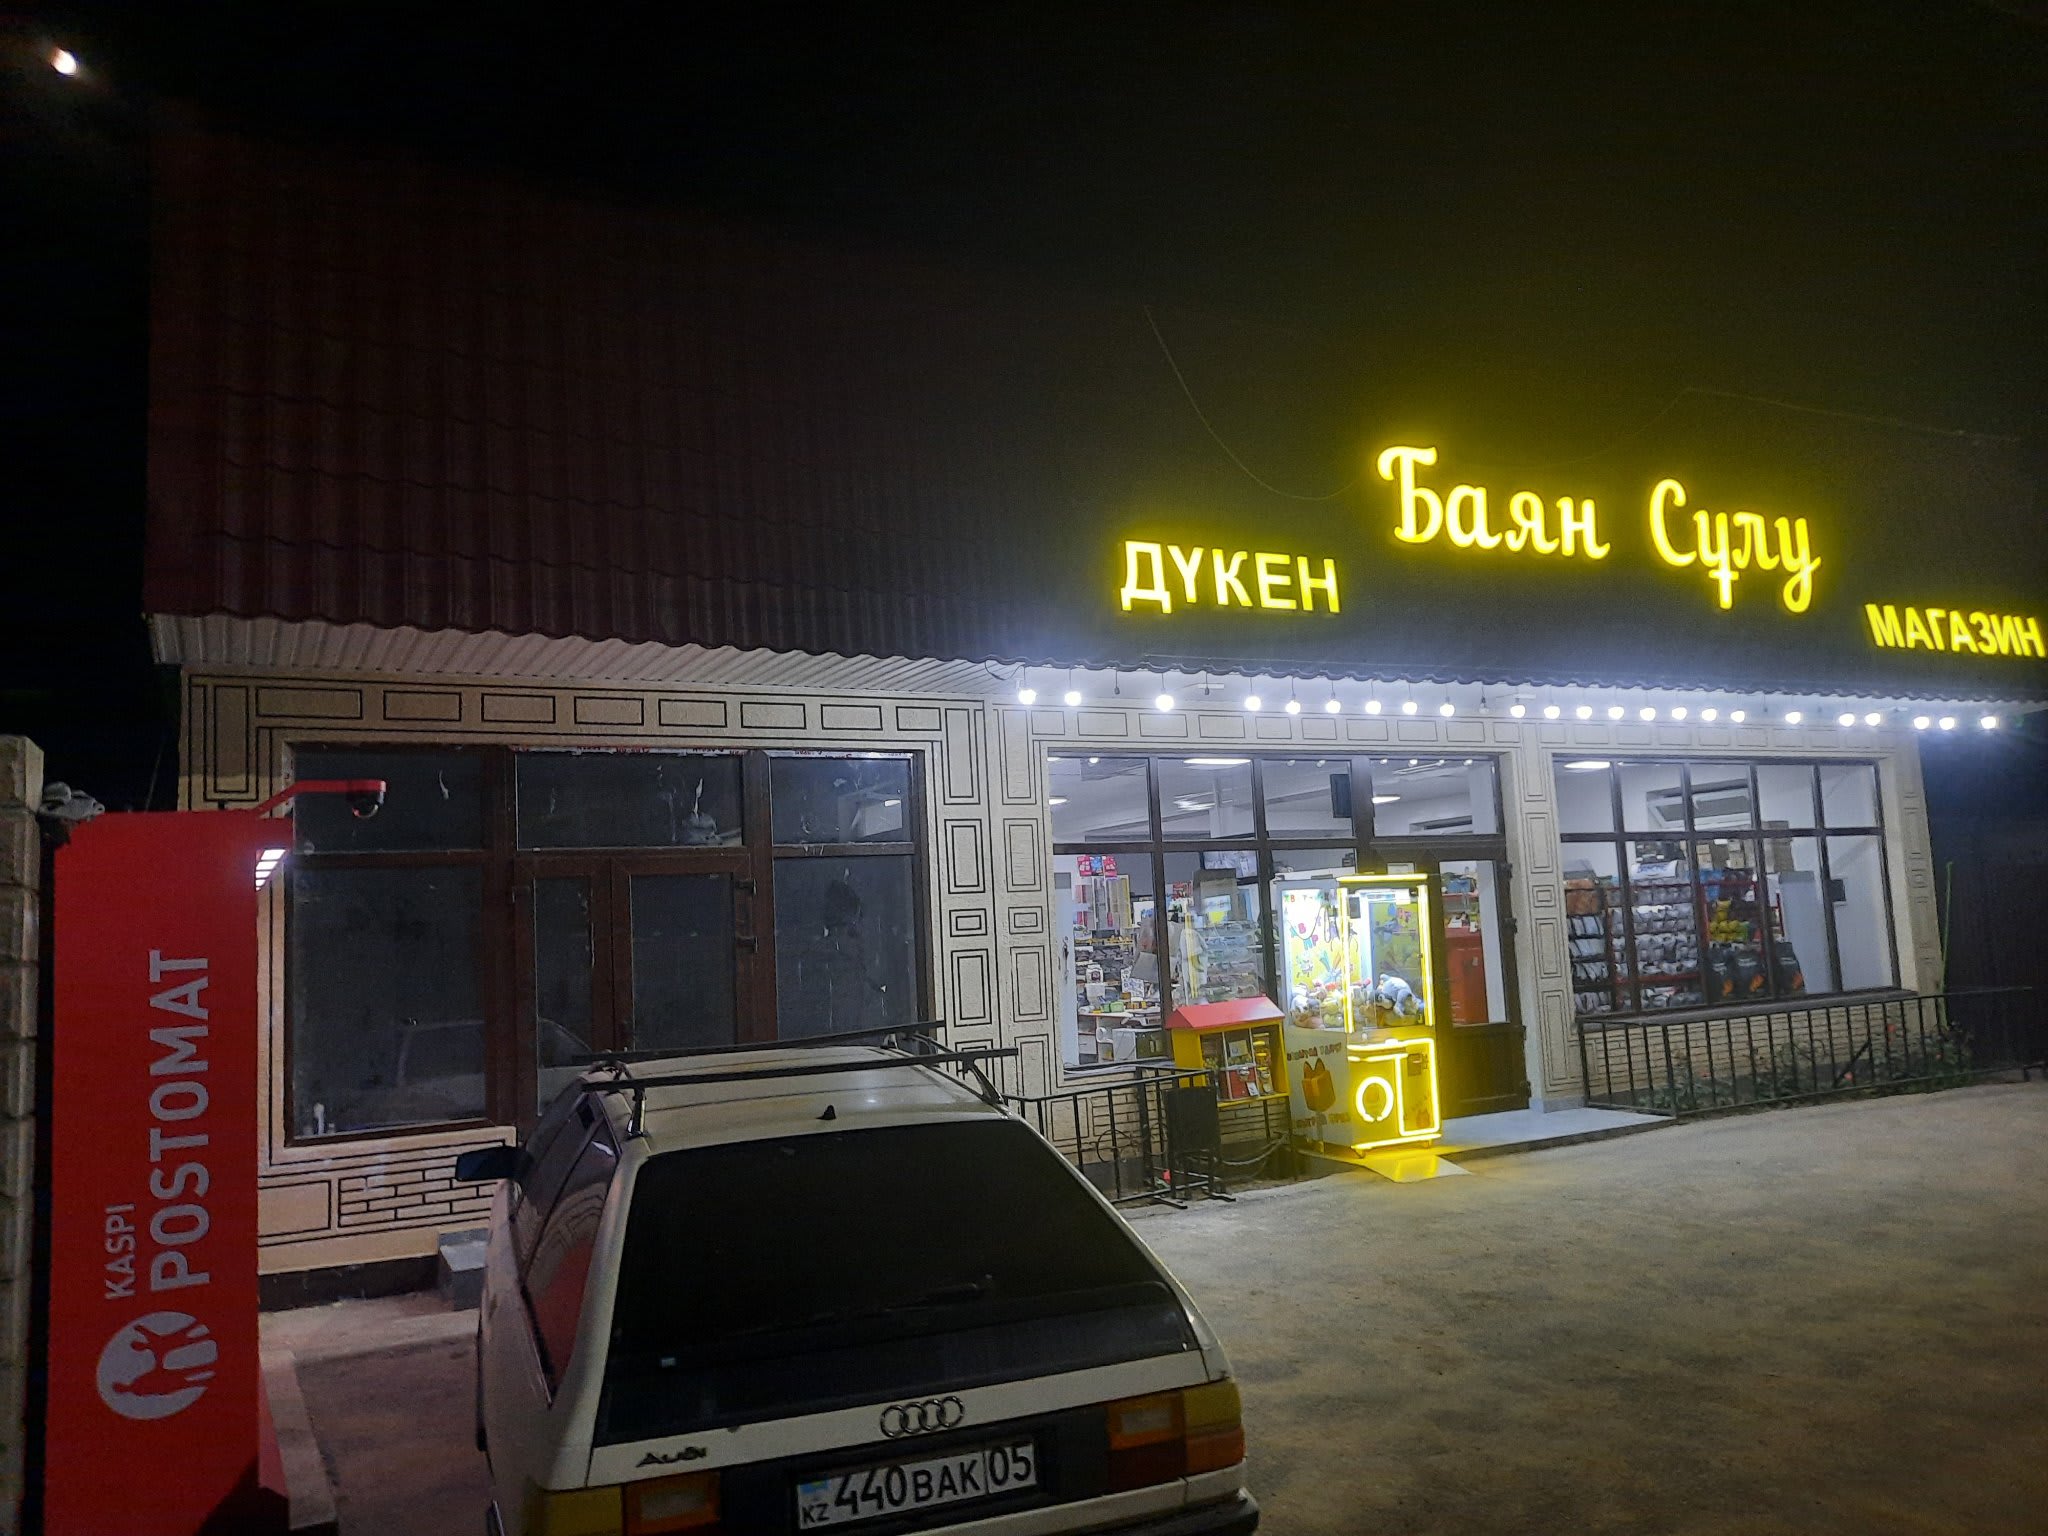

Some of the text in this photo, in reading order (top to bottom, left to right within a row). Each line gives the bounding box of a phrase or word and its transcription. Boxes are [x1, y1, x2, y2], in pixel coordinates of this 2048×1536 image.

[1375, 444, 1612, 561] Баян
[1119, 540, 1341, 614] ДҮКЕН
[1865, 603, 2047, 659] МАГАЗИН
[149, 950, 209, 1293] POSTOMAT
[106, 1204, 136, 1299] KASPI
[802, 1503, 829, 1524] KZ
